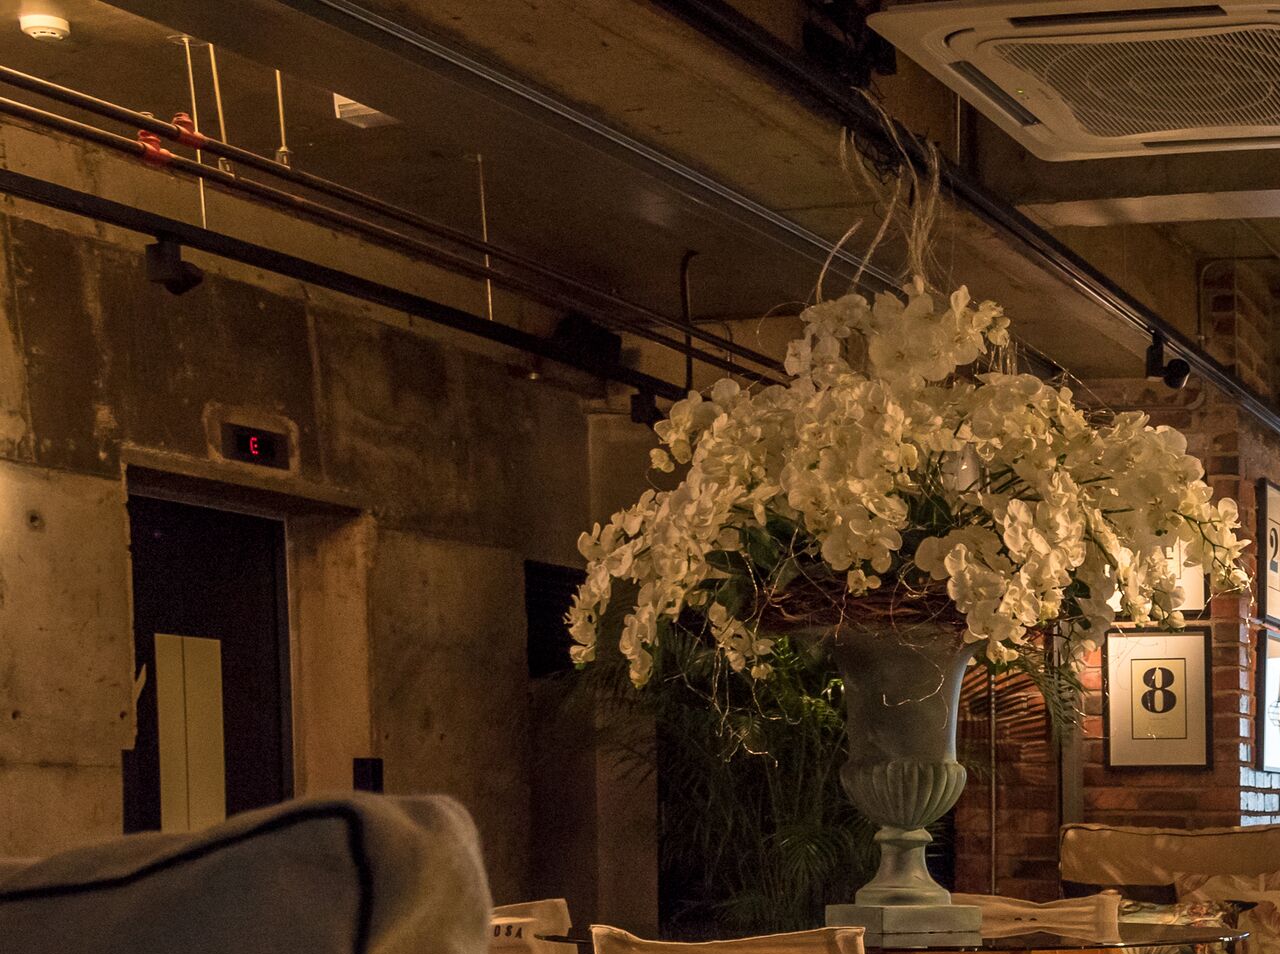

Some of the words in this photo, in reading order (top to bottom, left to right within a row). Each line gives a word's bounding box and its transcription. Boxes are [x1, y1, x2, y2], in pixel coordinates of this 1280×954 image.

[1269, 527, 1279, 573] 2
[1141, 666, 1177, 714] 8
[494, 924, 523, 939] OSA
